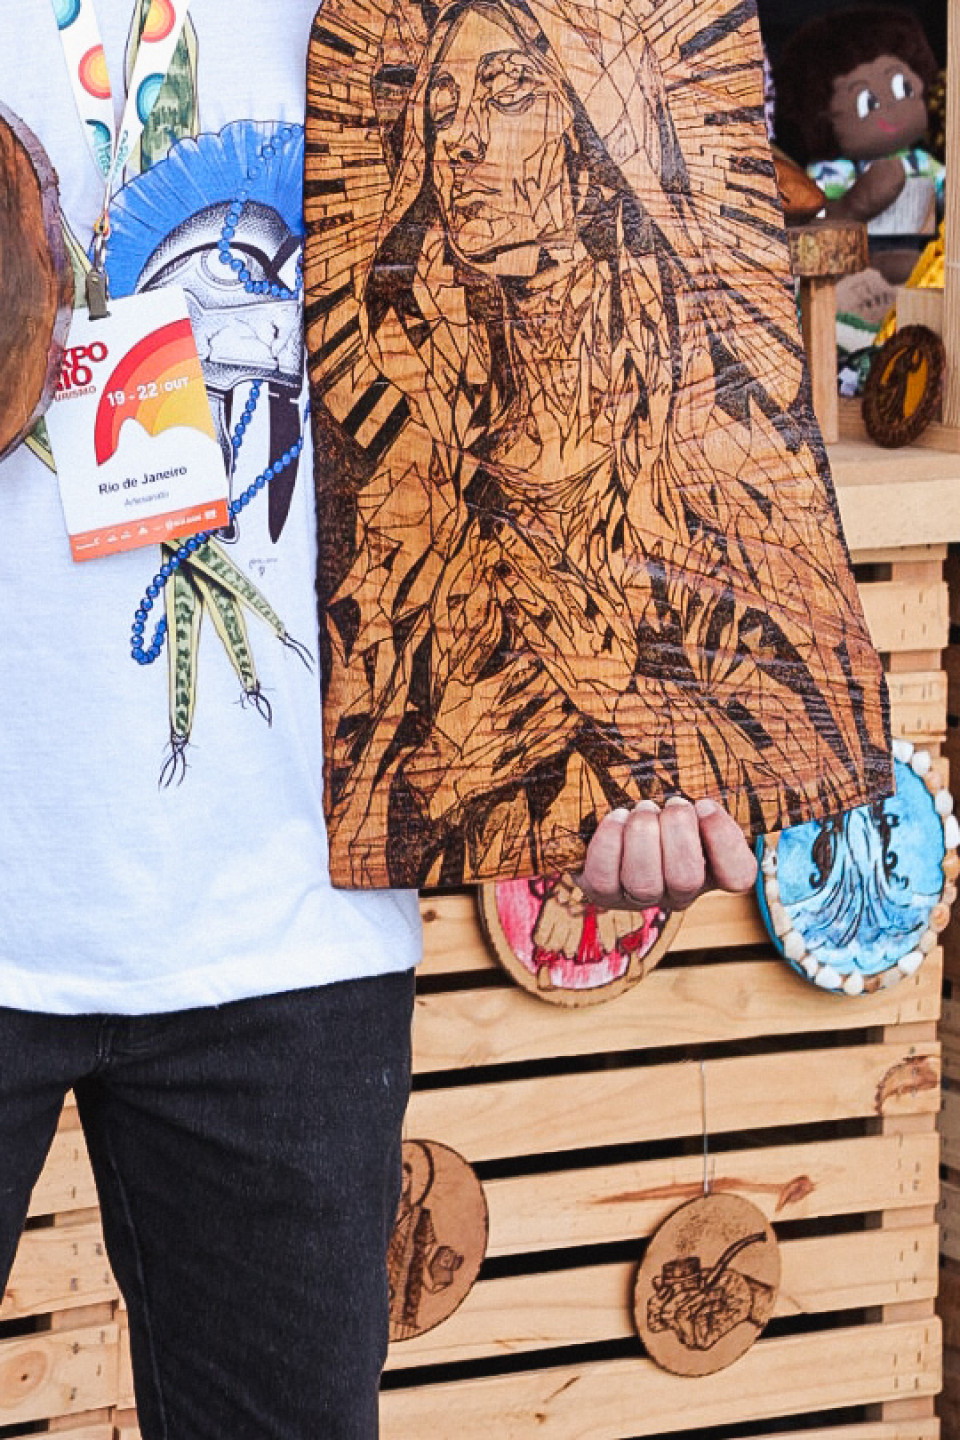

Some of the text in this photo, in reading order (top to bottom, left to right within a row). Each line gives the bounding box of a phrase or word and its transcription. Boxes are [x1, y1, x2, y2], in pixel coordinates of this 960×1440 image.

[107, 390, 125, 407] 19
[136, 382, 158, 401] 22
[164, 376, 189, 392] OUT
[98, 466, 188, 495] Rio de Janeiro
